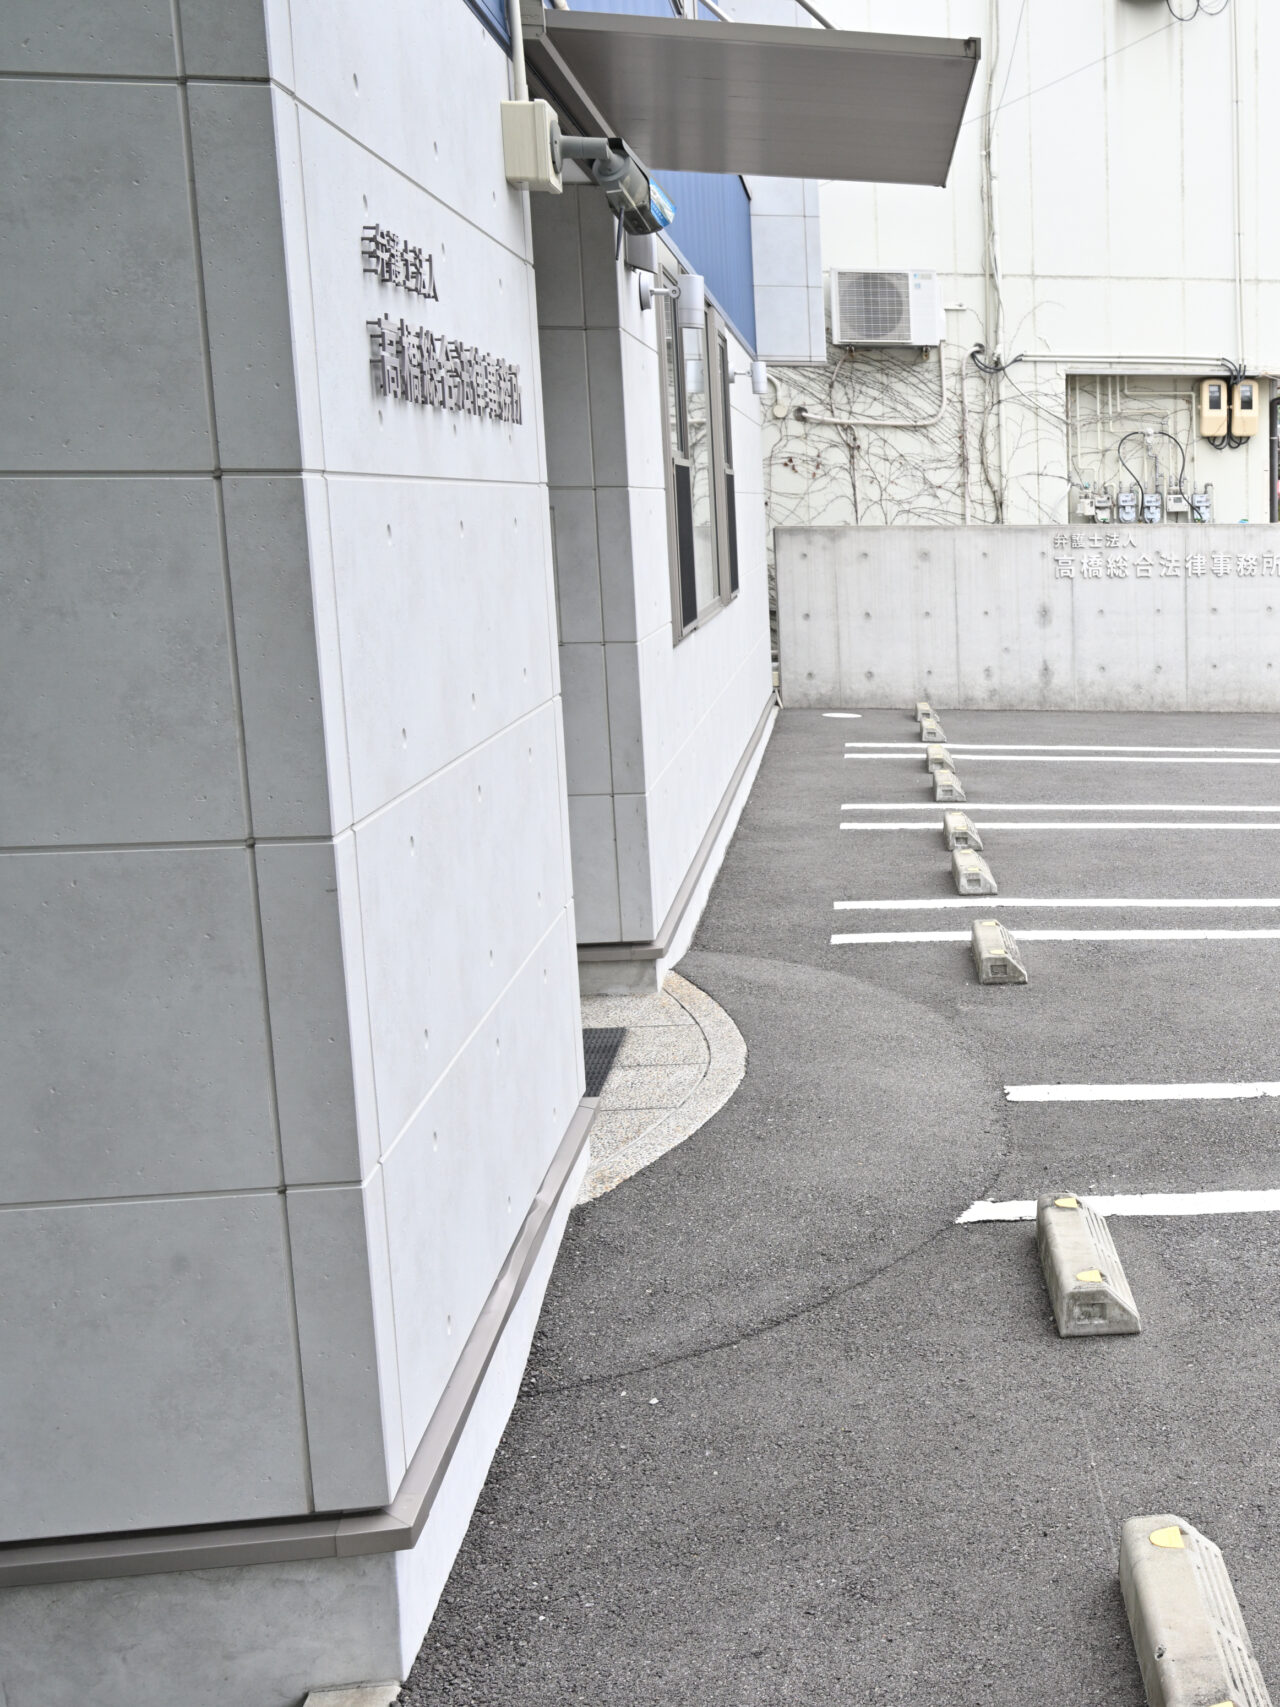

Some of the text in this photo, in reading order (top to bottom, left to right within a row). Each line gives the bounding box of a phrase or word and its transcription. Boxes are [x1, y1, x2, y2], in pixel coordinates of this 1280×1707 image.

[1053, 533, 1137, 548] 弁護士法人
